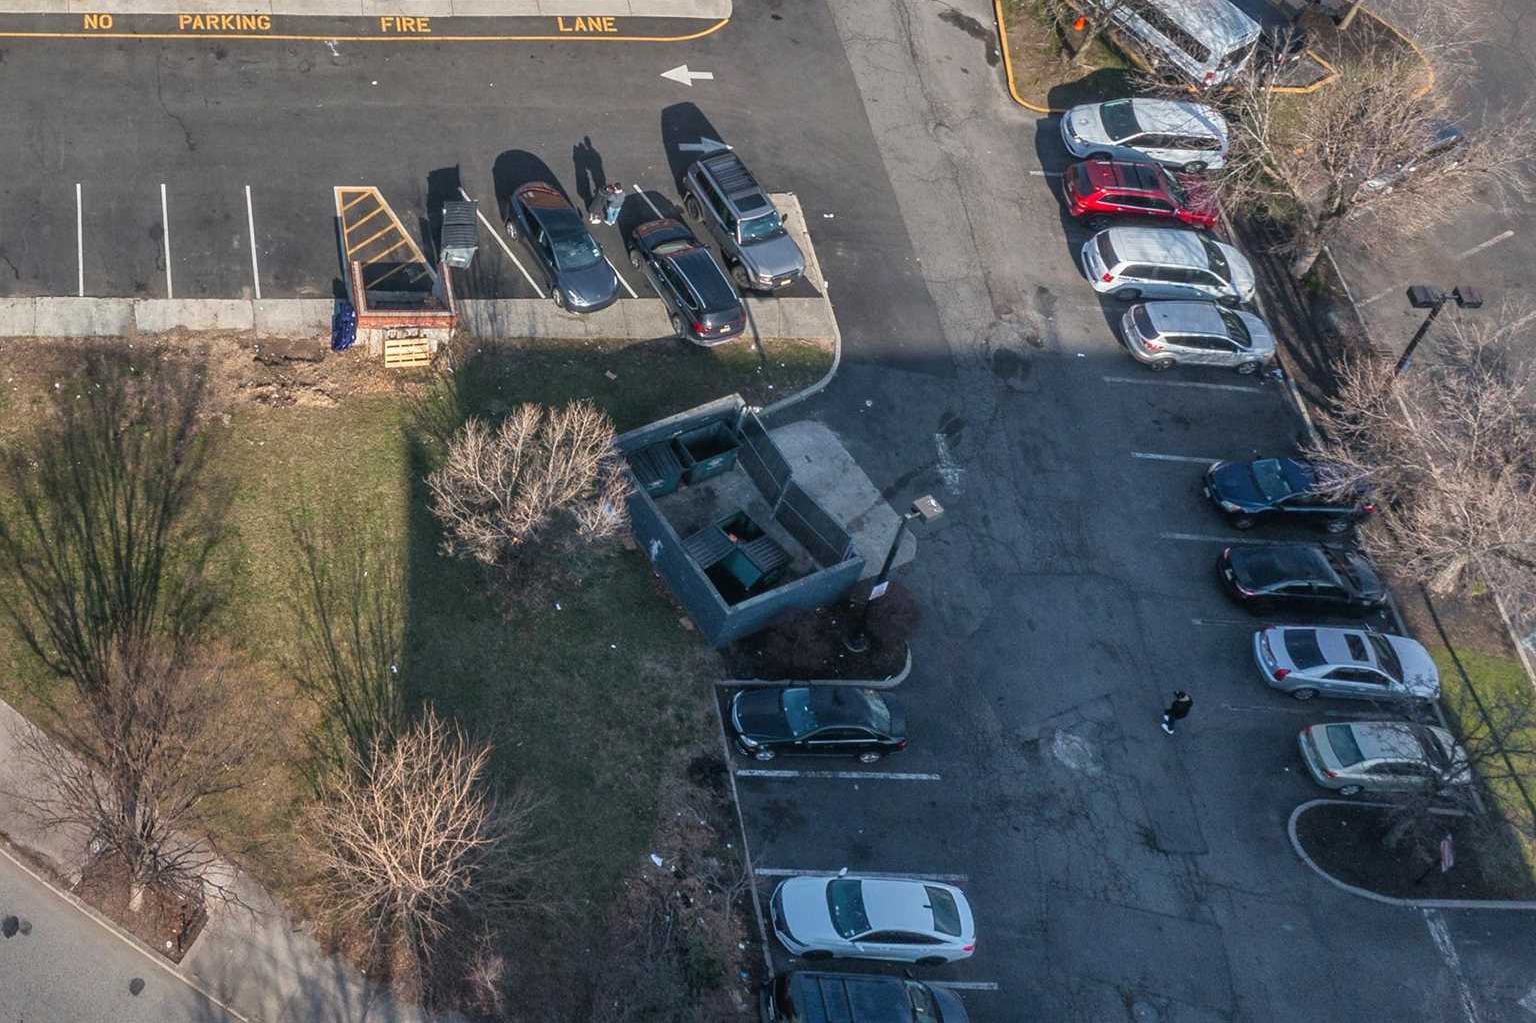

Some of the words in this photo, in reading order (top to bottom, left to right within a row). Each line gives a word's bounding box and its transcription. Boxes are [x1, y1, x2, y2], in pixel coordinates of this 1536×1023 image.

[84, 13, 113, 30] NO
[179, 14, 272, 31] PARKING
[381, 17, 432, 33] FIRE
[557, 17, 618, 33] LANE
